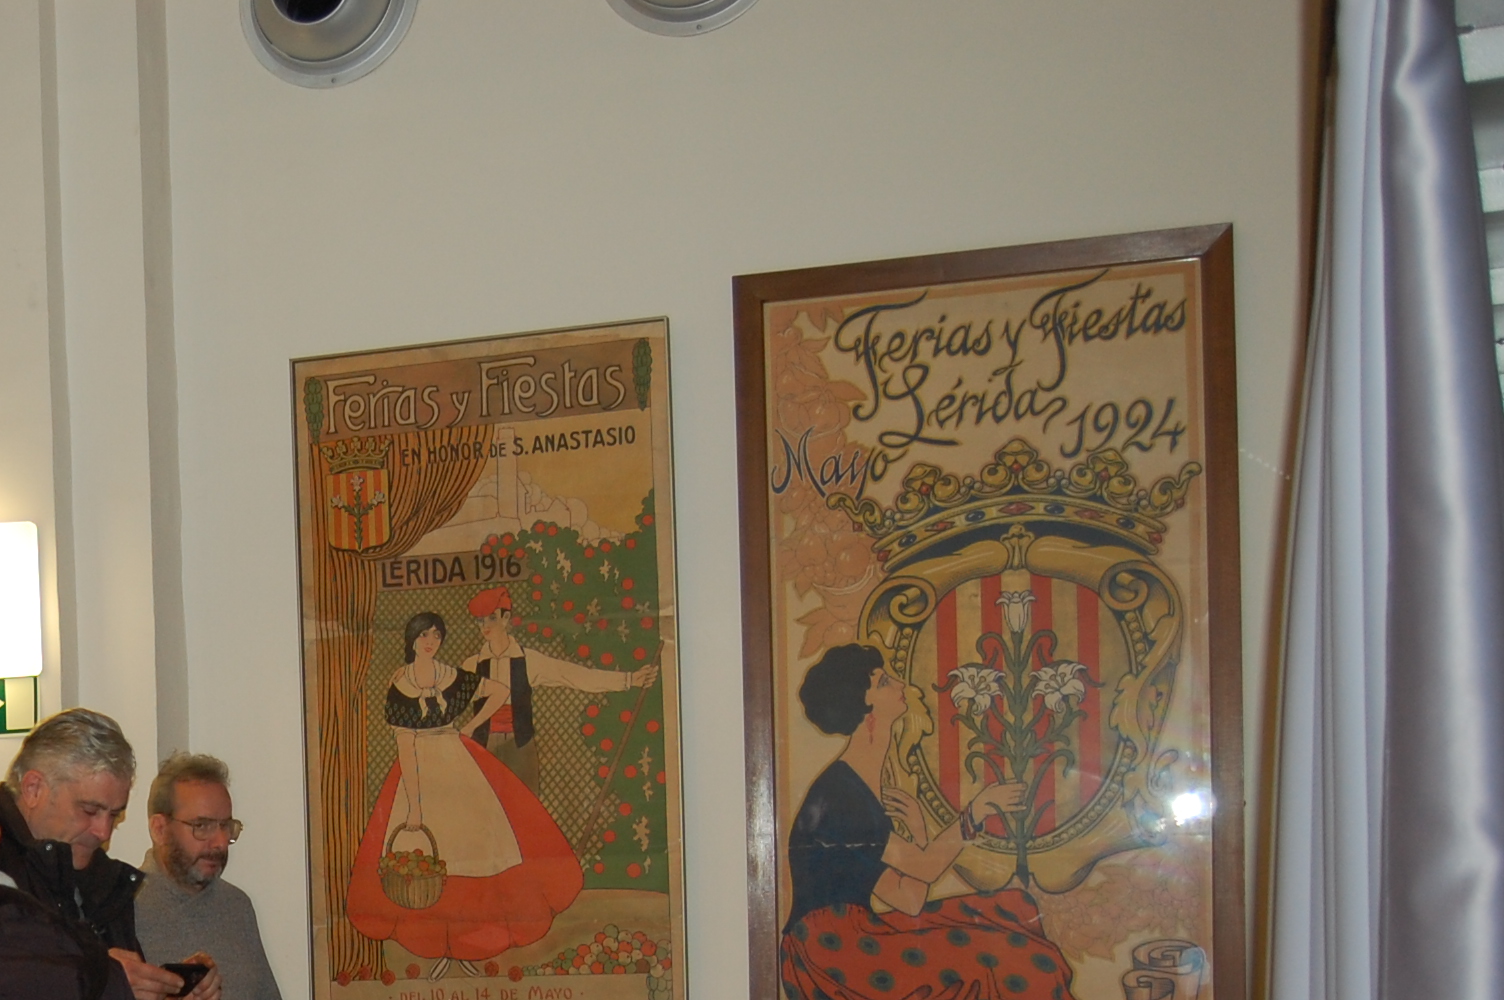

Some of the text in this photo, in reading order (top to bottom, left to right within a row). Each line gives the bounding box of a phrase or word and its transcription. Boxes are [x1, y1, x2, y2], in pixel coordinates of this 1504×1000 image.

[834, 268, 1188, 421] Ferias y Fiestas
[323, 356, 627, 435] Ferias y Fiestas
[878, 364, 1187, 460] Lérida 1924
[402, 425, 636, 467] EN HONOR DE S. ANASTASIO
[771, 425, 908, 500] Mayo
[474, 553, 522, 582] 1916
[475, 987, 491, 1000] 14
[500, 988, 518, 1000] DE
